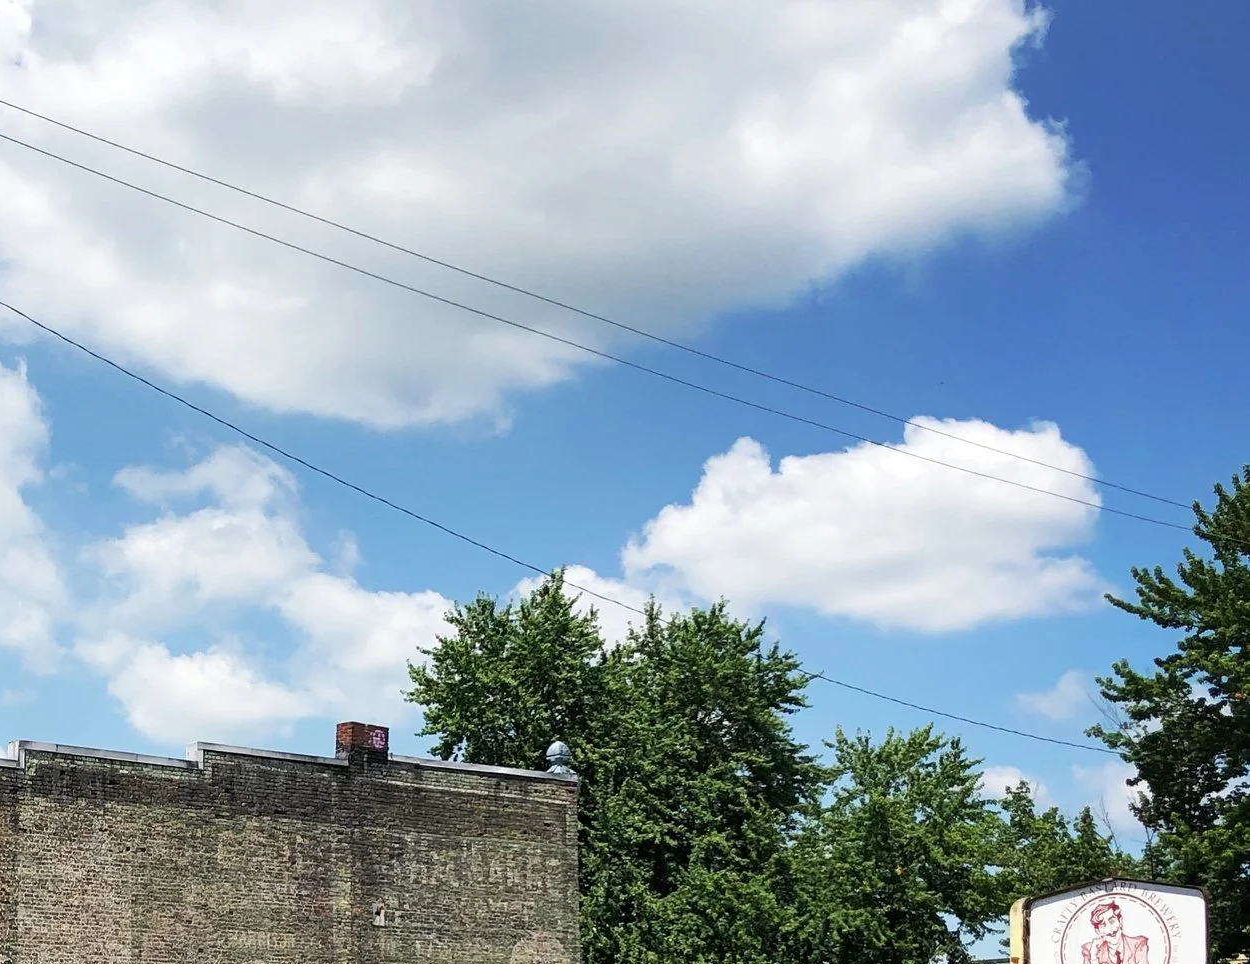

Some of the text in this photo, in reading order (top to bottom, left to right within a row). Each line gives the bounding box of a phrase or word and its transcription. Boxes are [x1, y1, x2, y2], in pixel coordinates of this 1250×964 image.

[1051, 882, 1183, 944] CRAFTY BASTARD BREWERY
